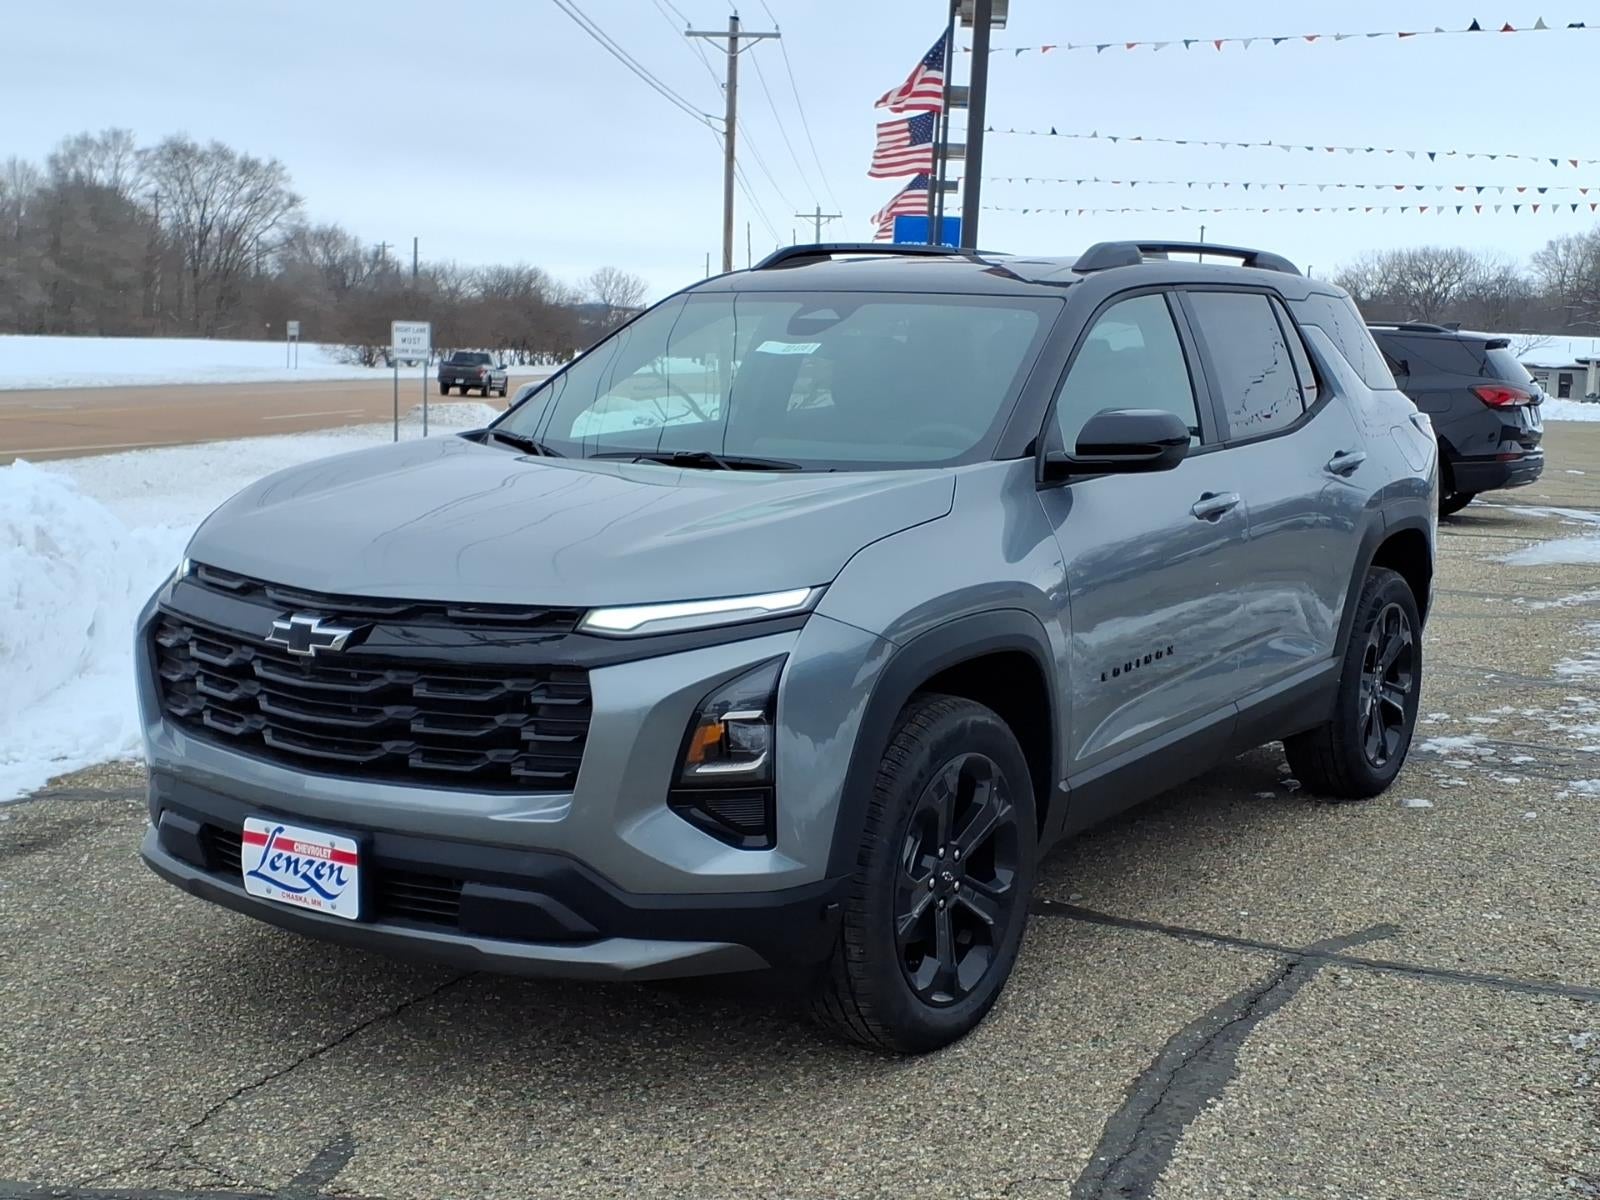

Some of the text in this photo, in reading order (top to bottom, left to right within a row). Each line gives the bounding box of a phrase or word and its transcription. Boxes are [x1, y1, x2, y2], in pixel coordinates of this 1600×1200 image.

[401, 337, 421, 345] MUST
[1101, 645, 1174, 682] EQUINOX
[246, 826, 350, 900] Lenzen
[293, 841, 332, 860] CHEVROLET
